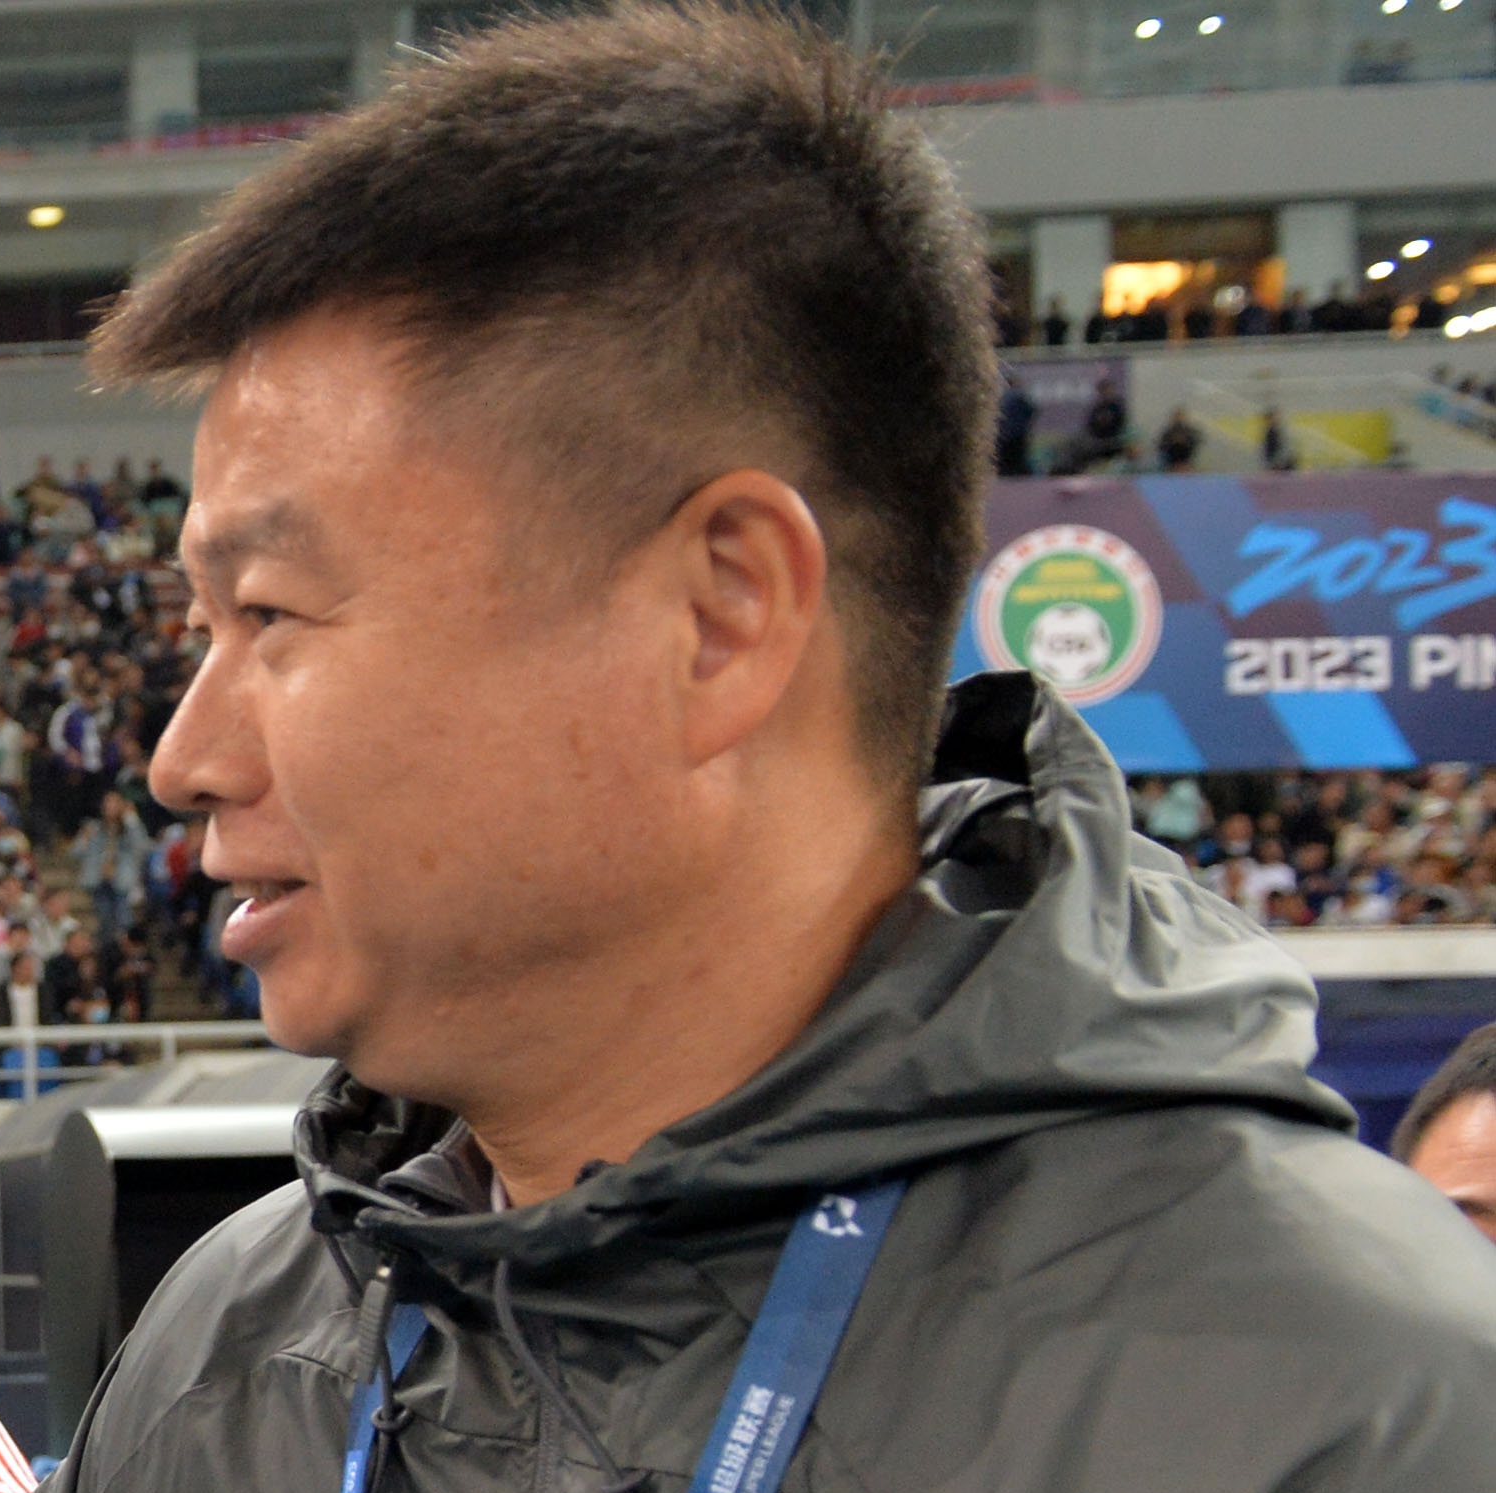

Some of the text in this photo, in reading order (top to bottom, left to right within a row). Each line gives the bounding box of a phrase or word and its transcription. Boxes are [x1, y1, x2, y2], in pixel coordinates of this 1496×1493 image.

[1226, 496, 1496, 629] 2023
[1224, 635, 1392, 694] 2023
[764, 1395, 796, 1453] LEAGUE
